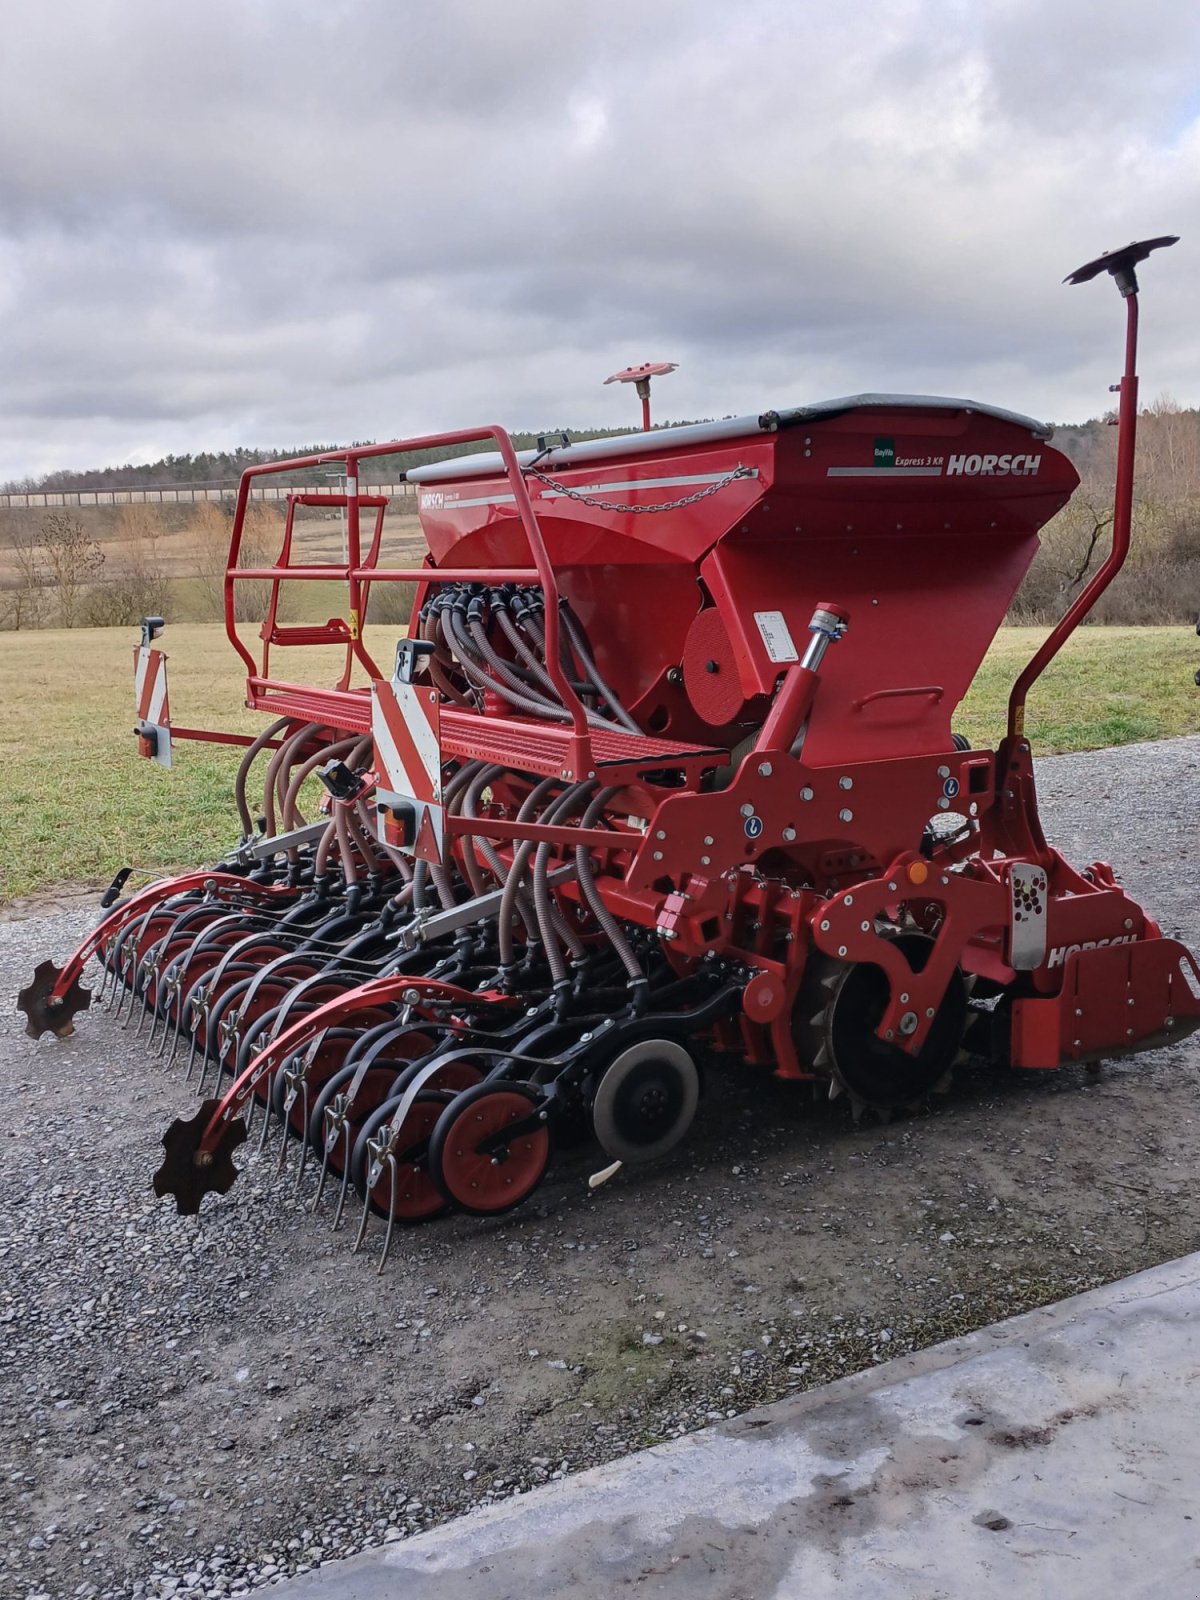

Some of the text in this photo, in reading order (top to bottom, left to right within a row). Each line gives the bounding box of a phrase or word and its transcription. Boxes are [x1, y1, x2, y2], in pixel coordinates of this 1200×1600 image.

[874, 448, 894, 457] BayWa
[895, 454, 1042, 476] Express 3 KR HORSCH
